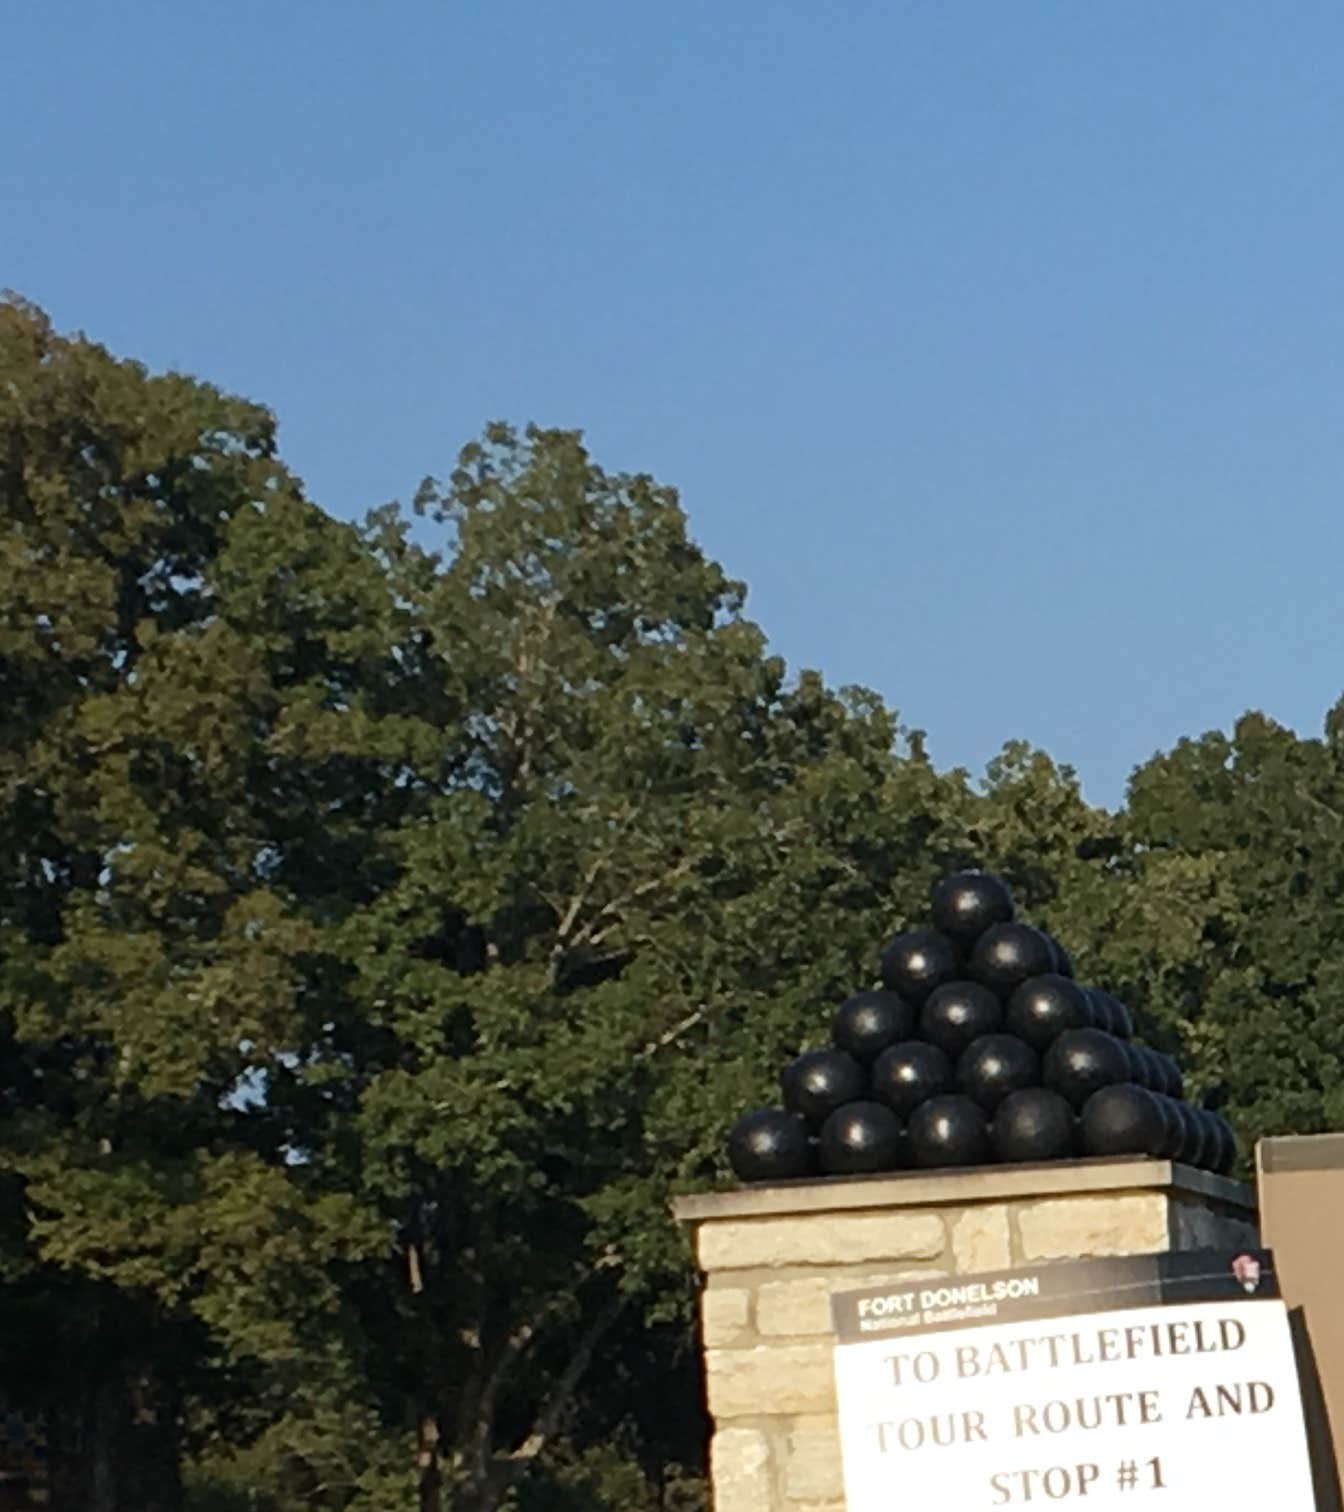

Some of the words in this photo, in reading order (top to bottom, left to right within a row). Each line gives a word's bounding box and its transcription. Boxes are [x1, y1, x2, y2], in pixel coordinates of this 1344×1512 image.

[857, 1292, 916, 1318] FORT
[919, 1276, 1040, 1309] DONELSON
[882, 1349, 941, 1388] TO
[953, 1316, 1247, 1380] BATTLEFIELD
[870, 1409, 989, 1455] TOUR
[1012, 1389, 1164, 1439] ROUTE
[1185, 1379, 1277, 1420] AND
[988, 1461, 1101, 1507] STOP
[1115, 1455, 1168, 1492] #1
